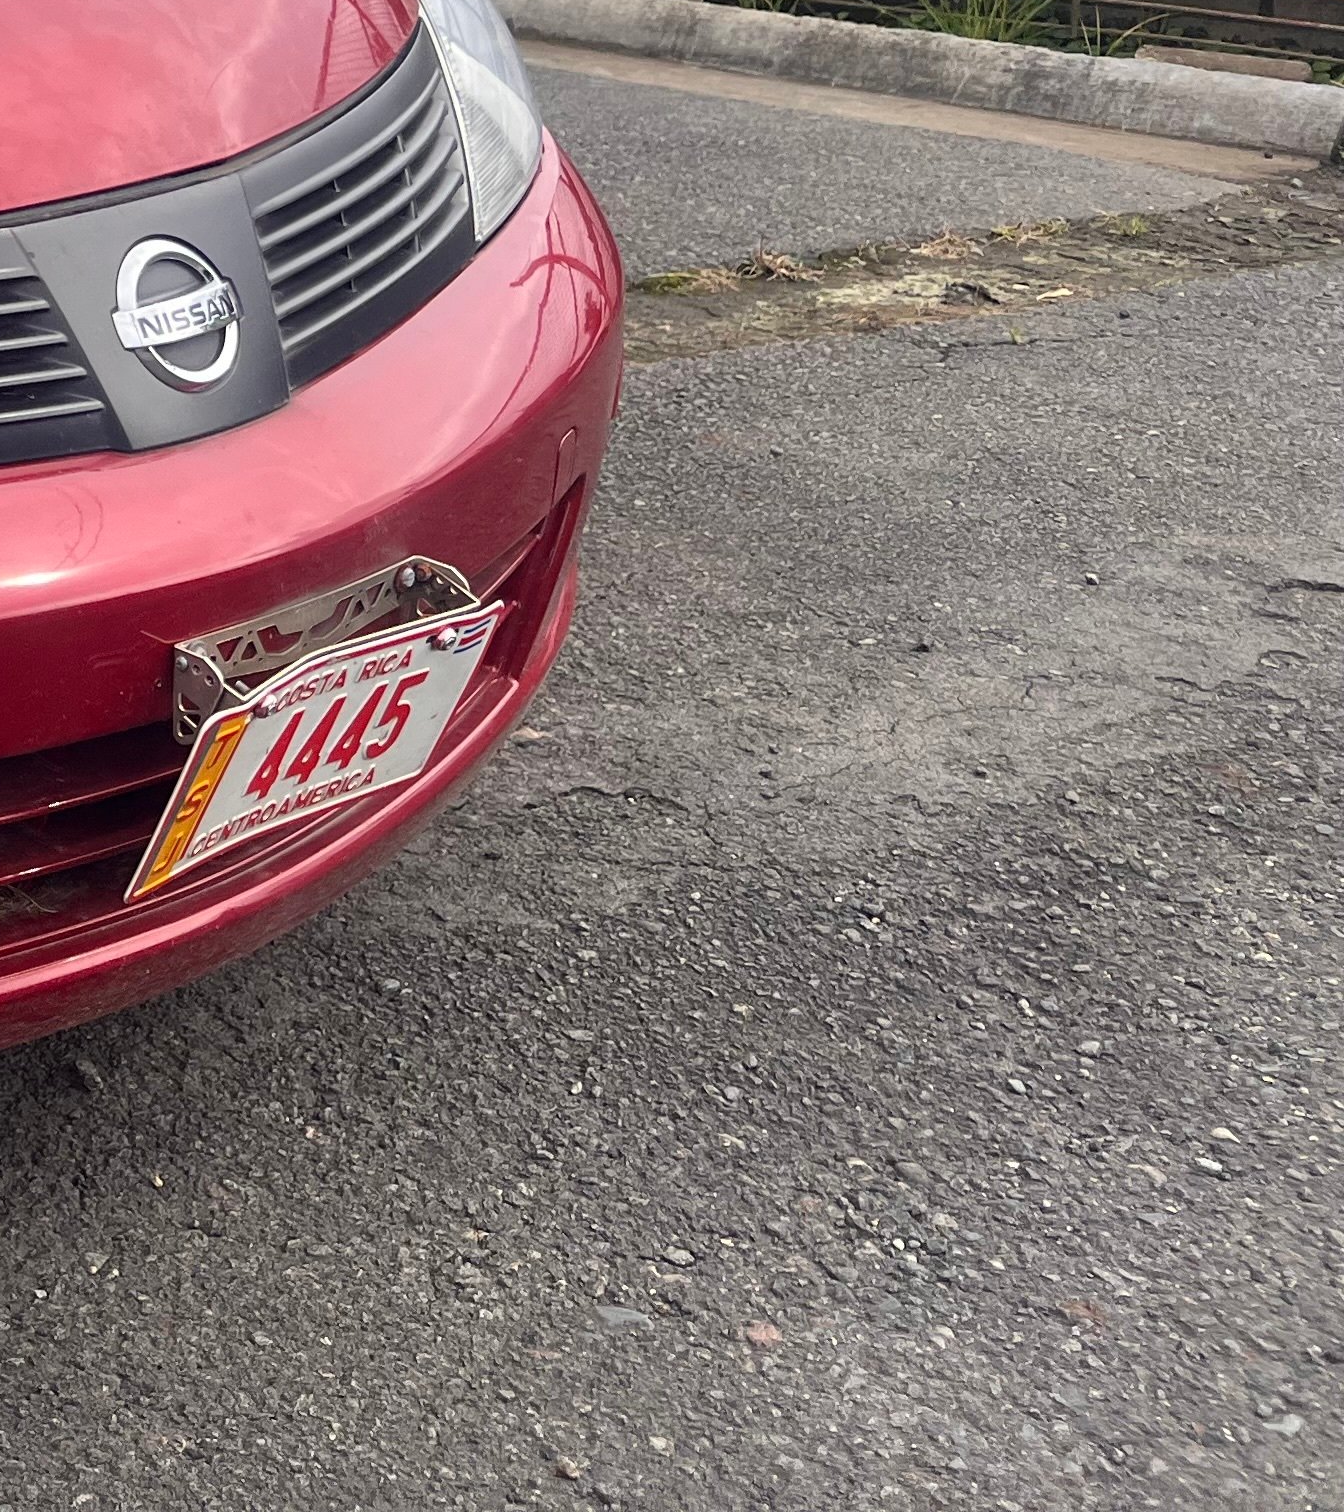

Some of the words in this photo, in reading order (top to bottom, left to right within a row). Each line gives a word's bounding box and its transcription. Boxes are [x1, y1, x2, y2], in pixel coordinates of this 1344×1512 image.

[137, 290, 236, 339] NISSAN
[273, 666, 346, 713] COSTA
[355, 645, 414, 684] RICA
[242, 666, 431, 802] 4445
[187, 764, 377, 858] CENTROAMERICA
